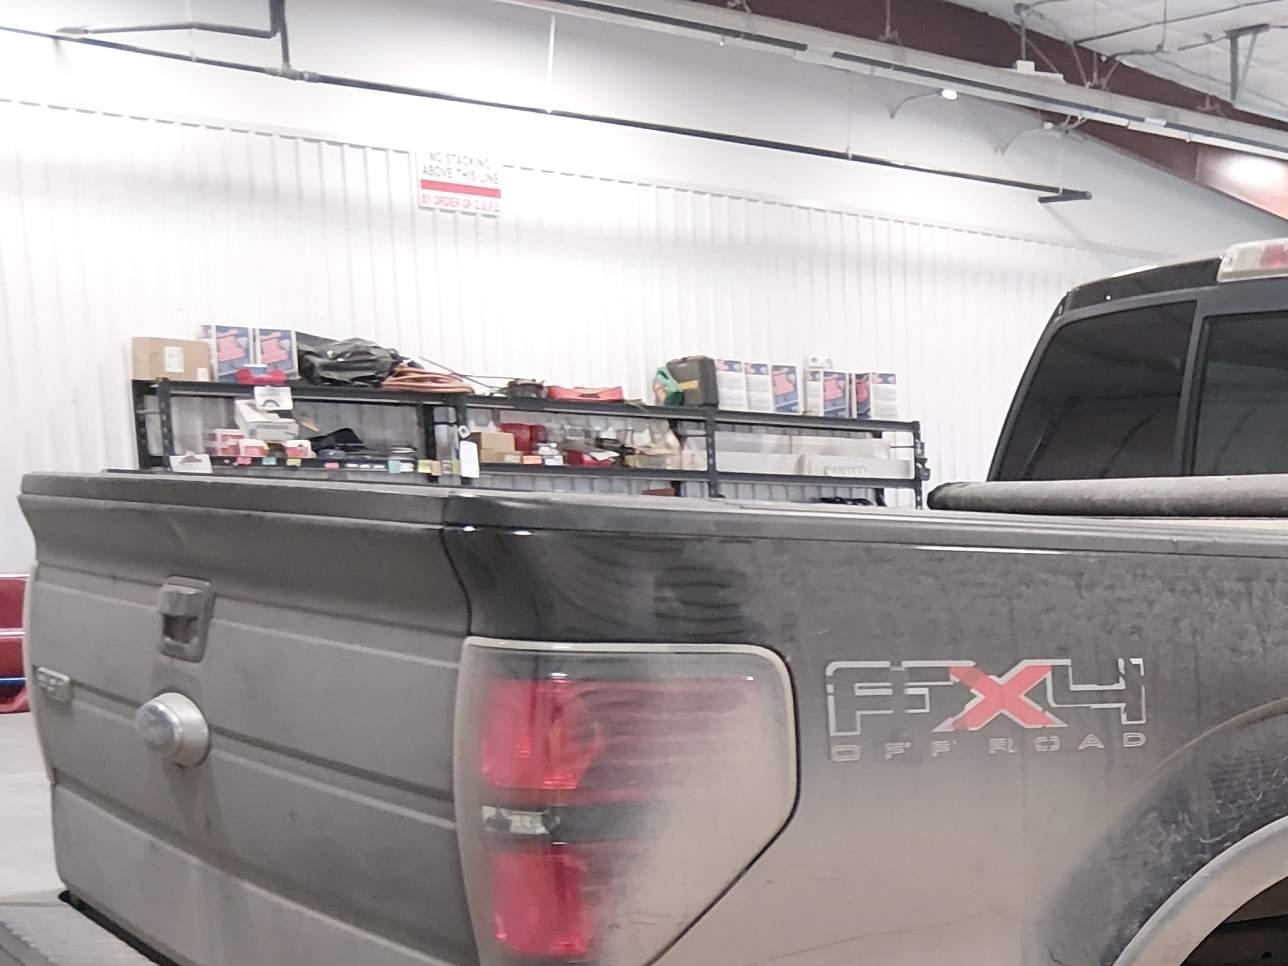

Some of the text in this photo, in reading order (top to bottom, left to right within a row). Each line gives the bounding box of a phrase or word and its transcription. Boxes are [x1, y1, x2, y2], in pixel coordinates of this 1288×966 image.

[423, 164, 453, 179] ABOVE
[826, 658, 1147, 736] FX4
[831, 732, 1147, 762] OFF ROAD
